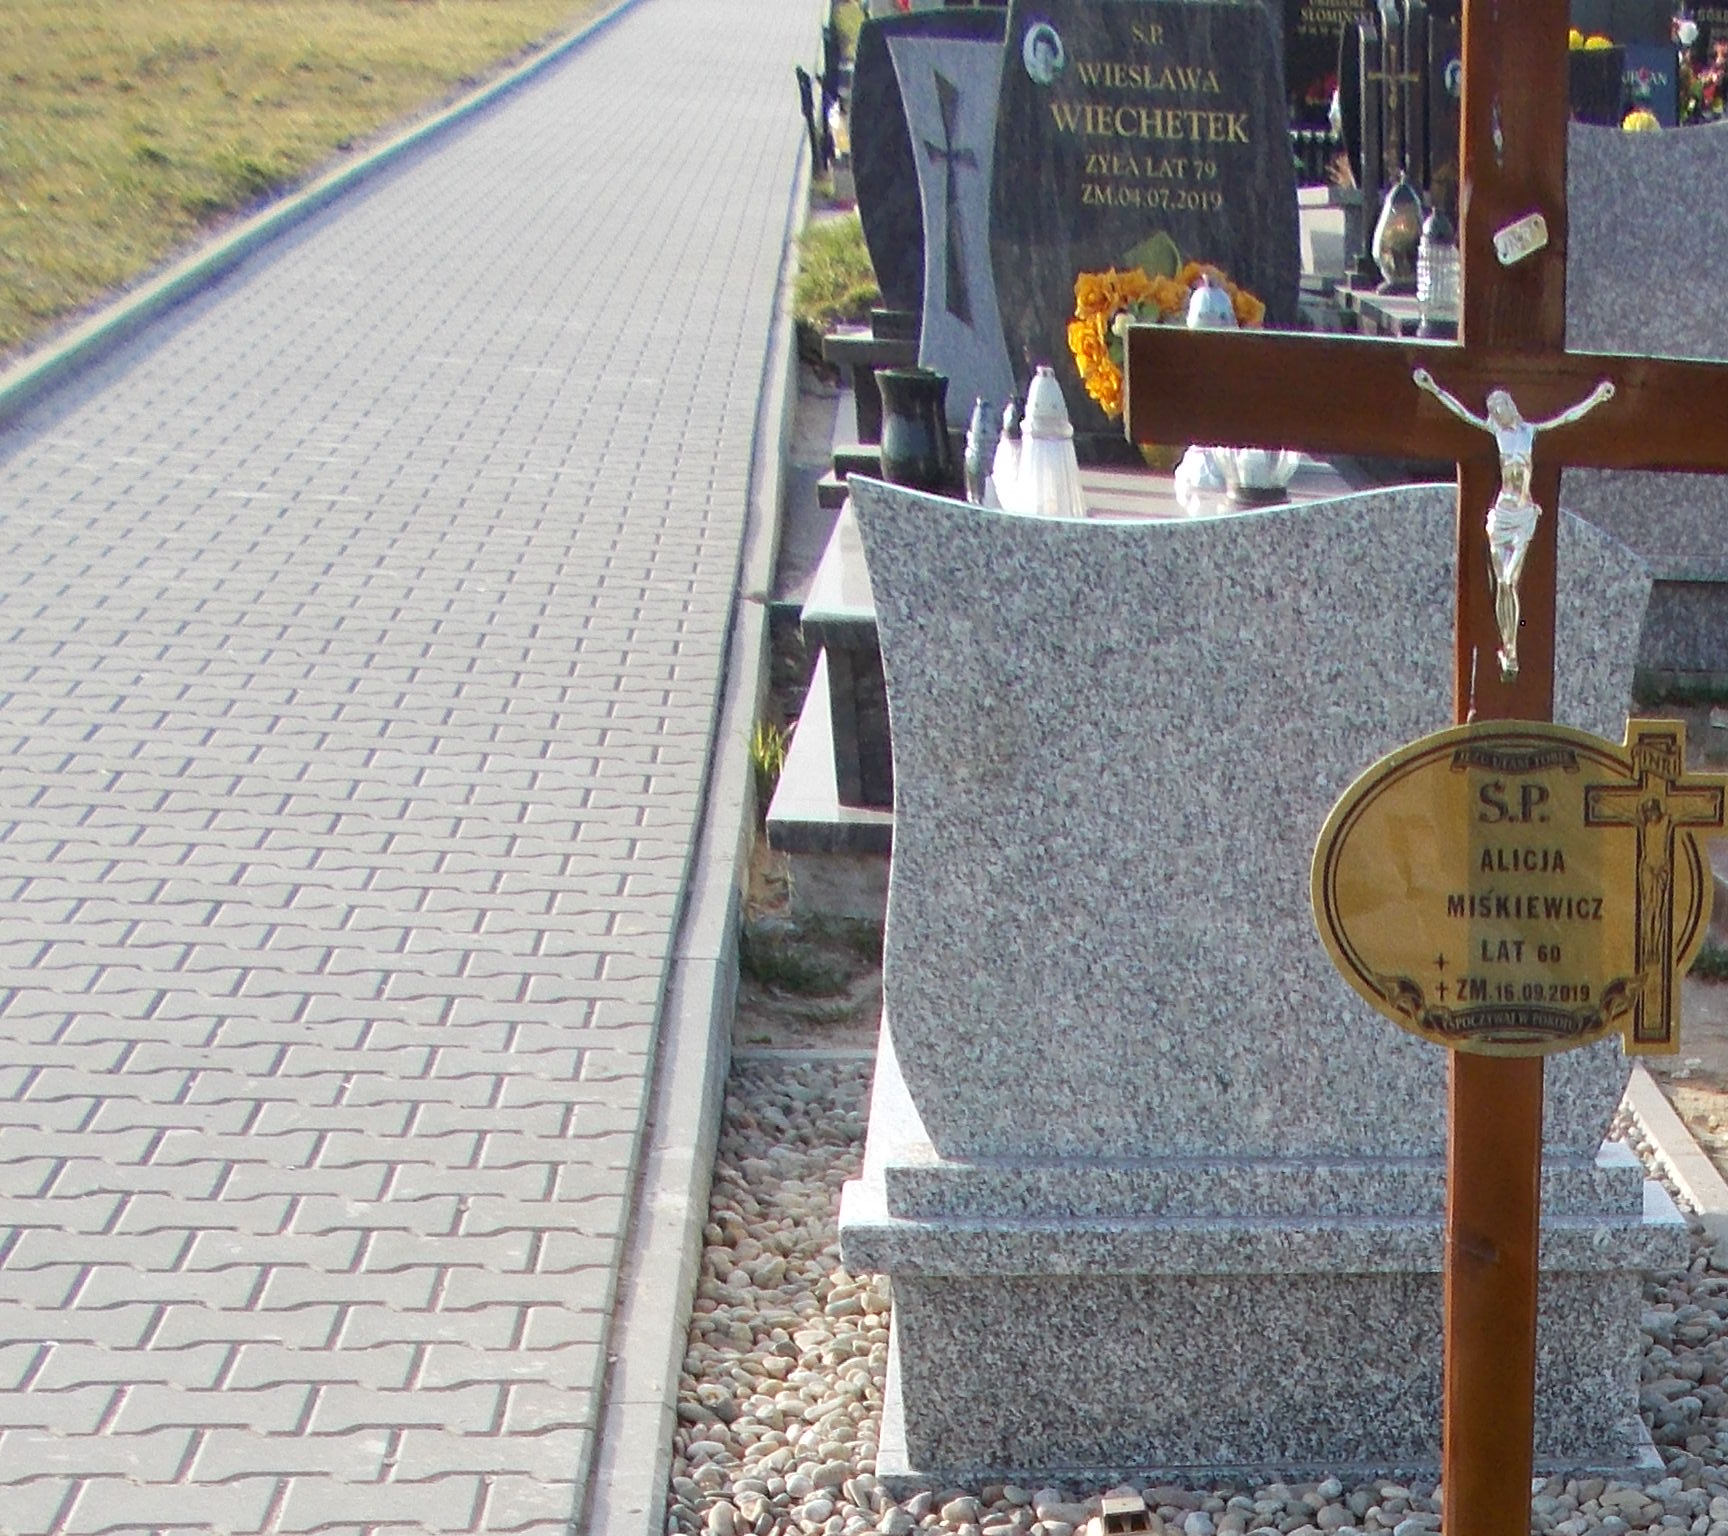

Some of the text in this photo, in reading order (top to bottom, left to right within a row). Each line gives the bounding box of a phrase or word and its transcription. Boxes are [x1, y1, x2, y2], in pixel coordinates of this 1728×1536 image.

[1050, 101, 1249, 143] WIECHETEK
[1643, 749, 1678, 778] INRI
[1480, 848, 1566, 875] ALICJA
[1447, 889, 1603, 920] MIŚKIEWICZ
[1481, 938, 1561, 963] LAT 60
